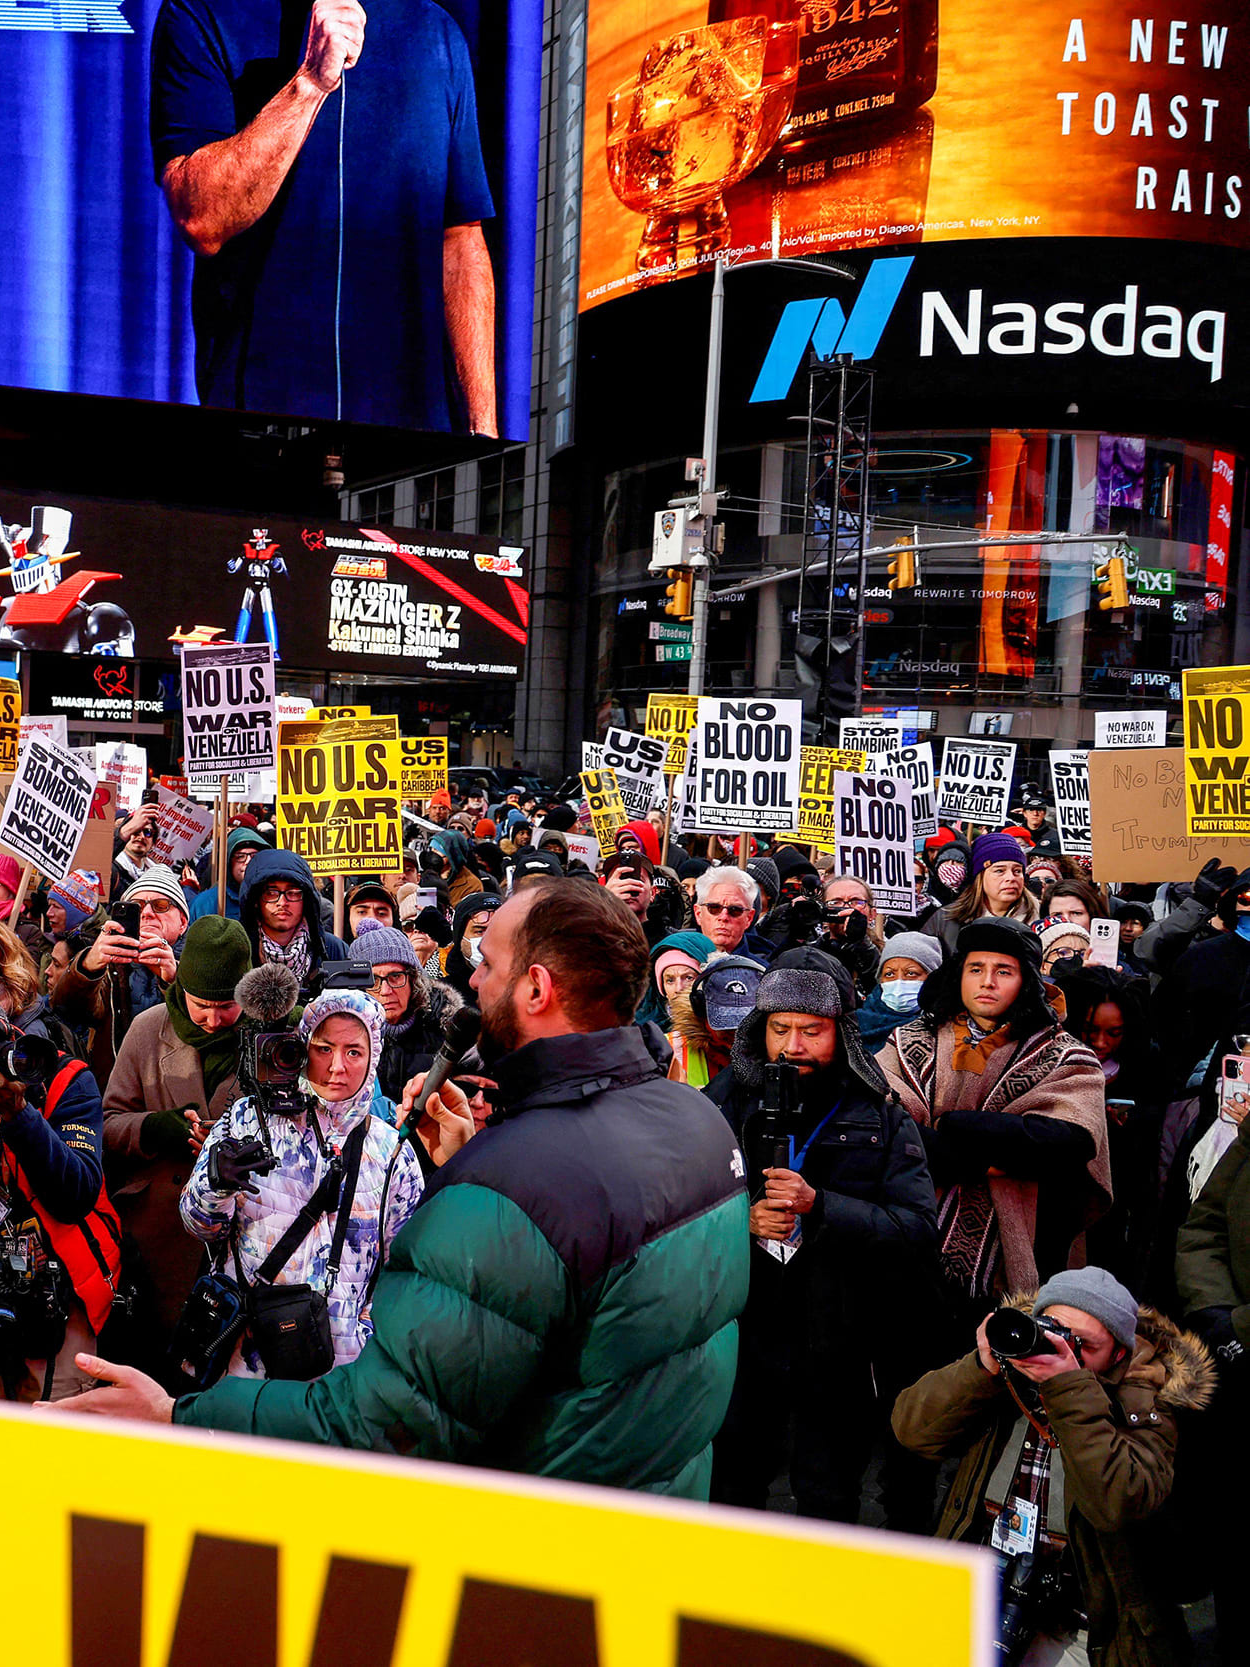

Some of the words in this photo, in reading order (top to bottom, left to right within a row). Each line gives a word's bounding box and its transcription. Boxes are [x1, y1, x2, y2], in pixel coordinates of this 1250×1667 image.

[1062, 19, 1086, 62] A
[1129, 20, 1228, 70] NEW
[1055, 91, 1219, 142] TOAST
[586, 284, 607, 300] PLEASE
[607, 278, 626, 292] DRINK
[818, 228, 862, 243] Imported
[864, 226, 877, 239] by
[879, 222, 916, 236] Diageo
[970, 218, 994, 228] New
[920, 284, 1227, 384] Nasdaq
[399, 543, 425, 557] STORE
[426, 547, 446, 559] NEW
[446, 549, 470, 561] YORK
[330, 578, 408, 603] GX-105TN
[913, 588, 966, 599] REWRITE
[971, 589, 1036, 600] TOMORROW
[1129, 594, 1161, 609] Nasdaq
[330, 597, 444, 628] MAZINGER
[446, 605, 462, 629] Z
[625, 600, 647, 610] Nasdaq
[403, 623, 460, 649] Shinka
[658, 625, 691, 642] Broadway
[363, 642, 402, 656] LIMITED
[665, 647, 673, 659] W
[675, 646, 685, 659] 43
[899, 658, 960, 676] Nasdaq
[186, 668, 223, 708] NO
[226, 666, 271, 704] U.S.
[83, 710, 105, 718] NEW
[107, 711, 132, 719] YORK
[134, 700, 164, 713] STORE
[719, 702, 777, 722] NO
[186, 710, 273, 733] WAR
[843, 727, 899, 737] STOP
[1107, 722, 1122, 733] NO
[1121, 722, 1139, 733] WAR
[1139, 720, 1155, 732] ON
[187, 729, 273, 758] VENEZUELA
[400, 739, 444, 755] US
[609, 730, 665, 763] US
[704, 722, 793, 762] BLOOD
[1106, 733, 1156, 745] VENEZUELA!
[29, 741, 93, 796] STOP
[280, 747, 328, 795] NO
[332, 743, 397, 792] U.S.
[400, 755, 445, 766] OUT
[603, 752, 660, 778] OUT
[944, 752, 971, 778] NO
[974, 757, 1007, 782] U.S.
[24, 756, 88, 826] BOMBING
[401, 780, 445, 792] CARIBBEAN
[700, 768, 747, 806] FOR
[752, 771, 793, 808] OIL
[852, 777, 897, 800] NO
[943, 781, 1005, 799] WAR
[280, 797, 398, 826] WAR
[941, 794, 1003, 814] VENEZUELA
[13, 786, 79, 853] VENEZUELA
[701, 815, 791, 829] PSLWEB.ORG
[841, 797, 907, 843] BLOOD
[5, 810, 71, 868] NOW!
[281, 822, 398, 856] VENEZUELA
[887, 848, 912, 888] OIL
